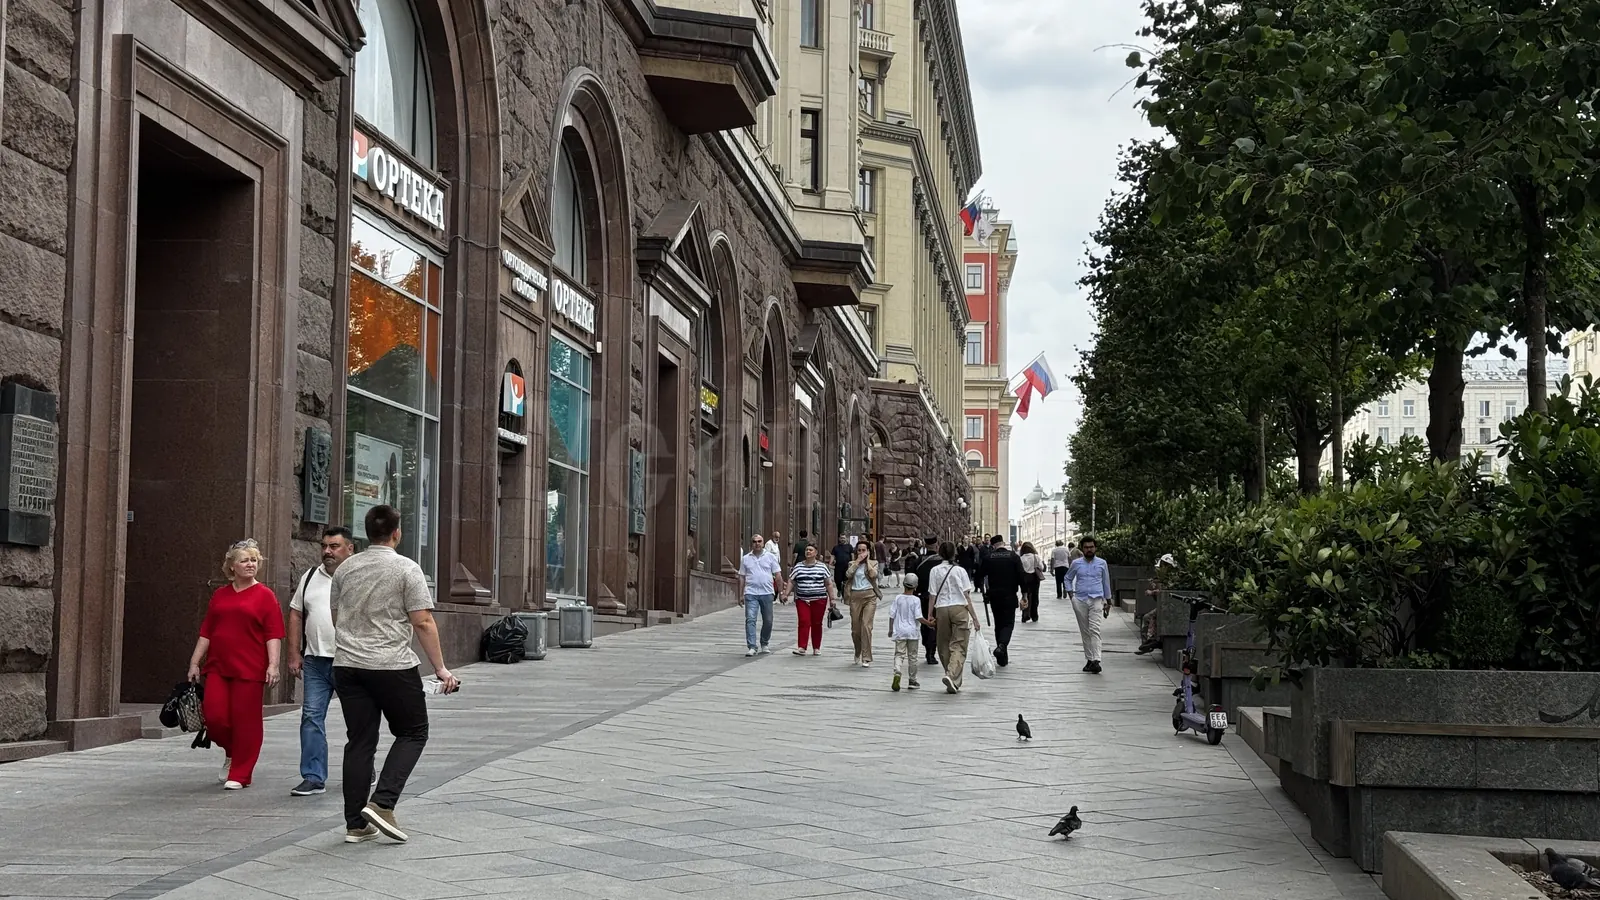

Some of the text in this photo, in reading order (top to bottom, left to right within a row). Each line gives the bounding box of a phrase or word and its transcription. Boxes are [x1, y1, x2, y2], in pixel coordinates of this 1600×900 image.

[371, 147, 445, 231] ОРТЕКА
[553, 279, 595, 334] ОРТЕКА
[19, 474, 52, 489] КОНСТАНТИН
[18, 485, 46, 497] ИВАНОВИЧ
[18, 494, 51, 512] СКРЯБИН
